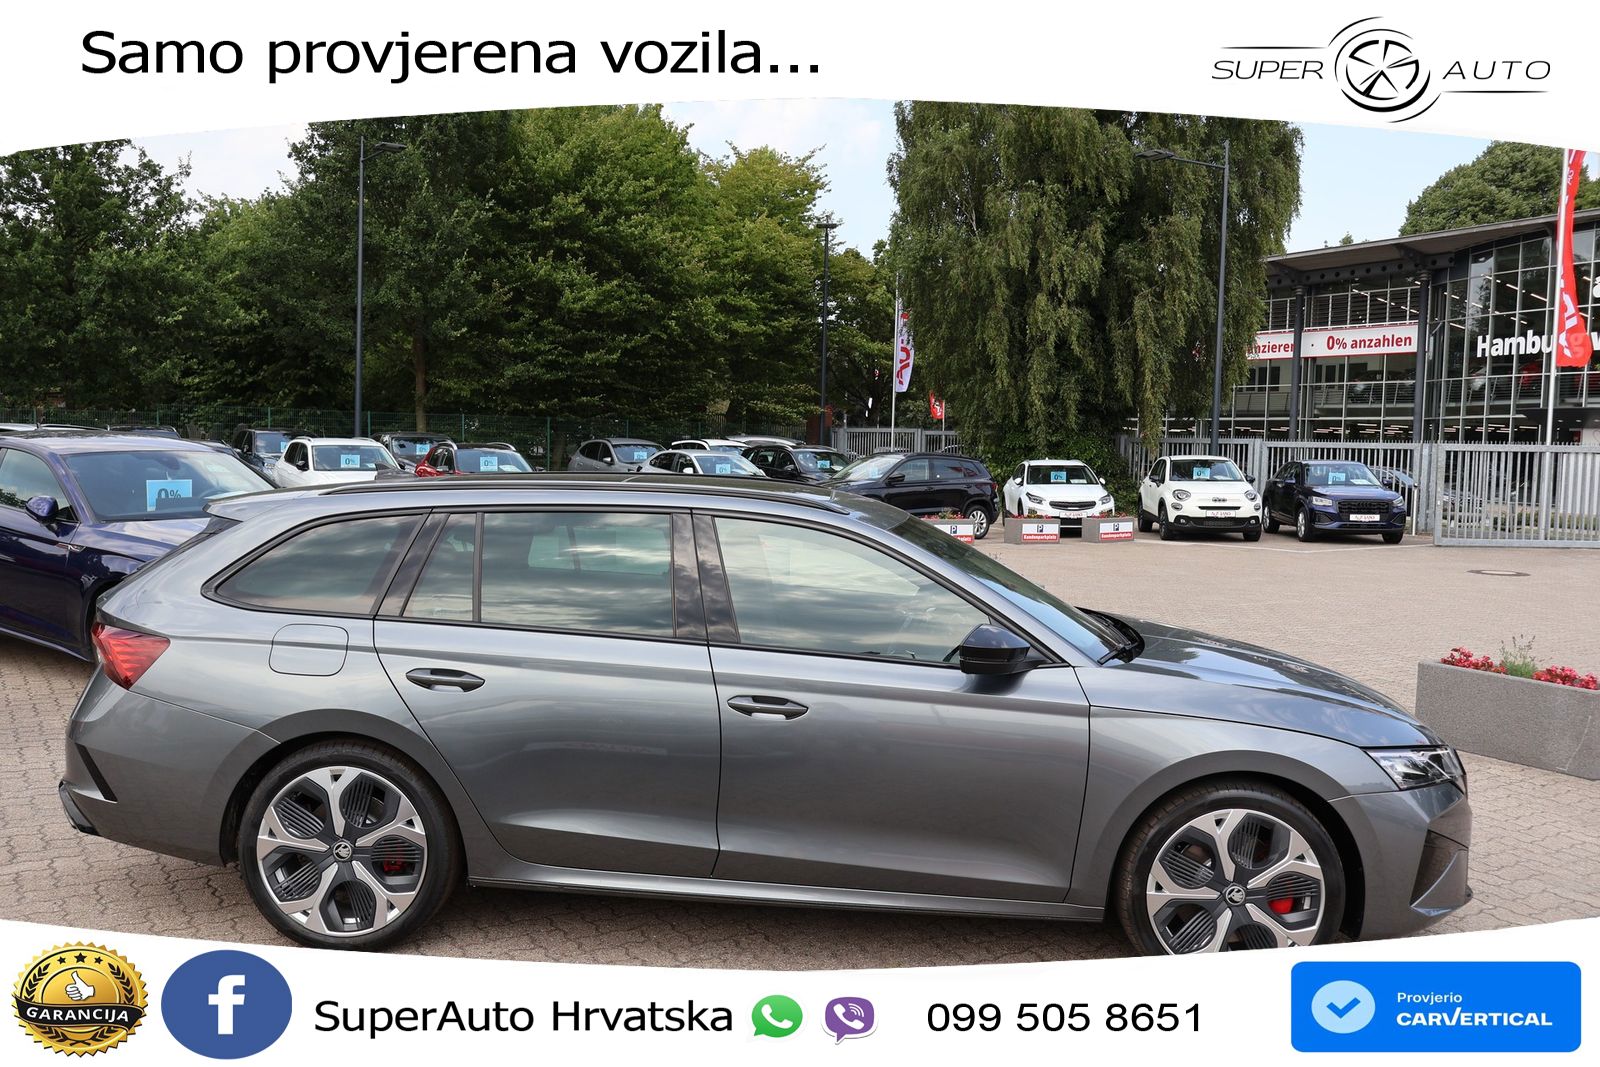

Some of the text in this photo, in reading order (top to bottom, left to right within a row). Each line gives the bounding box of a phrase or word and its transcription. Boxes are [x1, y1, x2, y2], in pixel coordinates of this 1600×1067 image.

[1326, 335, 1347, 350] 0%
[1350, 333, 1412, 348] anzahlen
[1476, 329, 1585, 358] Hambug
[157, 487, 182, 499] 0%
